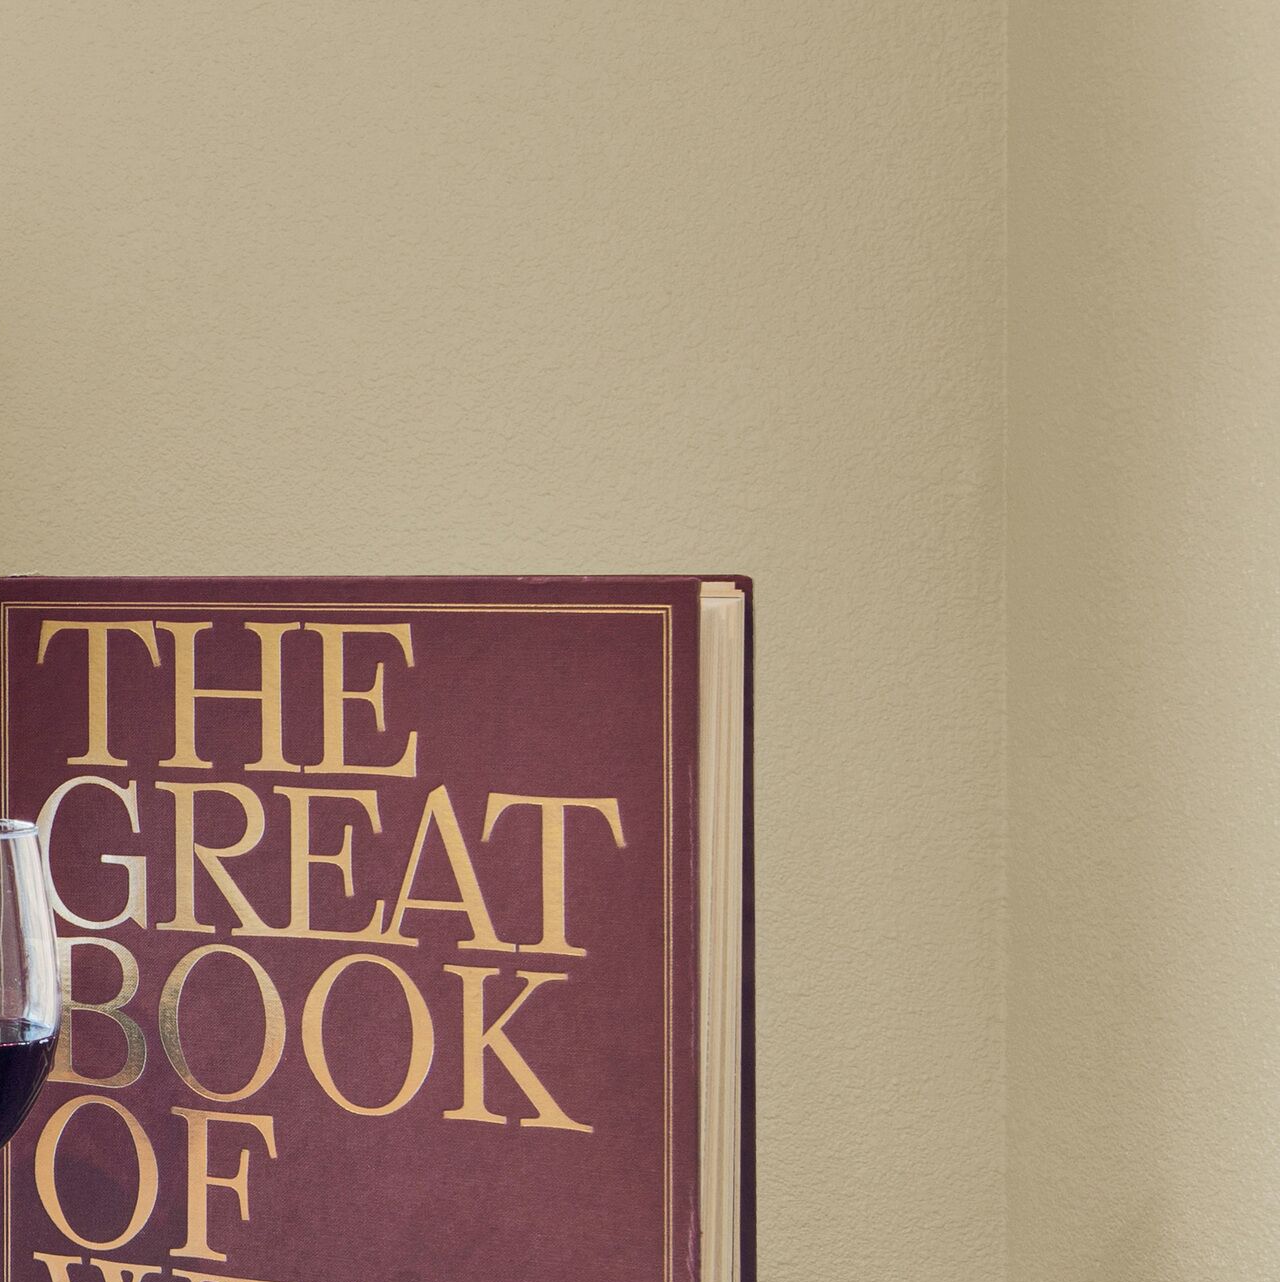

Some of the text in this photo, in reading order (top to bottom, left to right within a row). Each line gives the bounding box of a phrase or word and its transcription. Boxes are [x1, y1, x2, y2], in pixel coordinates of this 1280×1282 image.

[38, 620, 418, 778] THE
[38, 775, 627, 957] GREAT
[46, 936, 594, 1133] BOOK
[34, 1094, 278, 1262] OF
